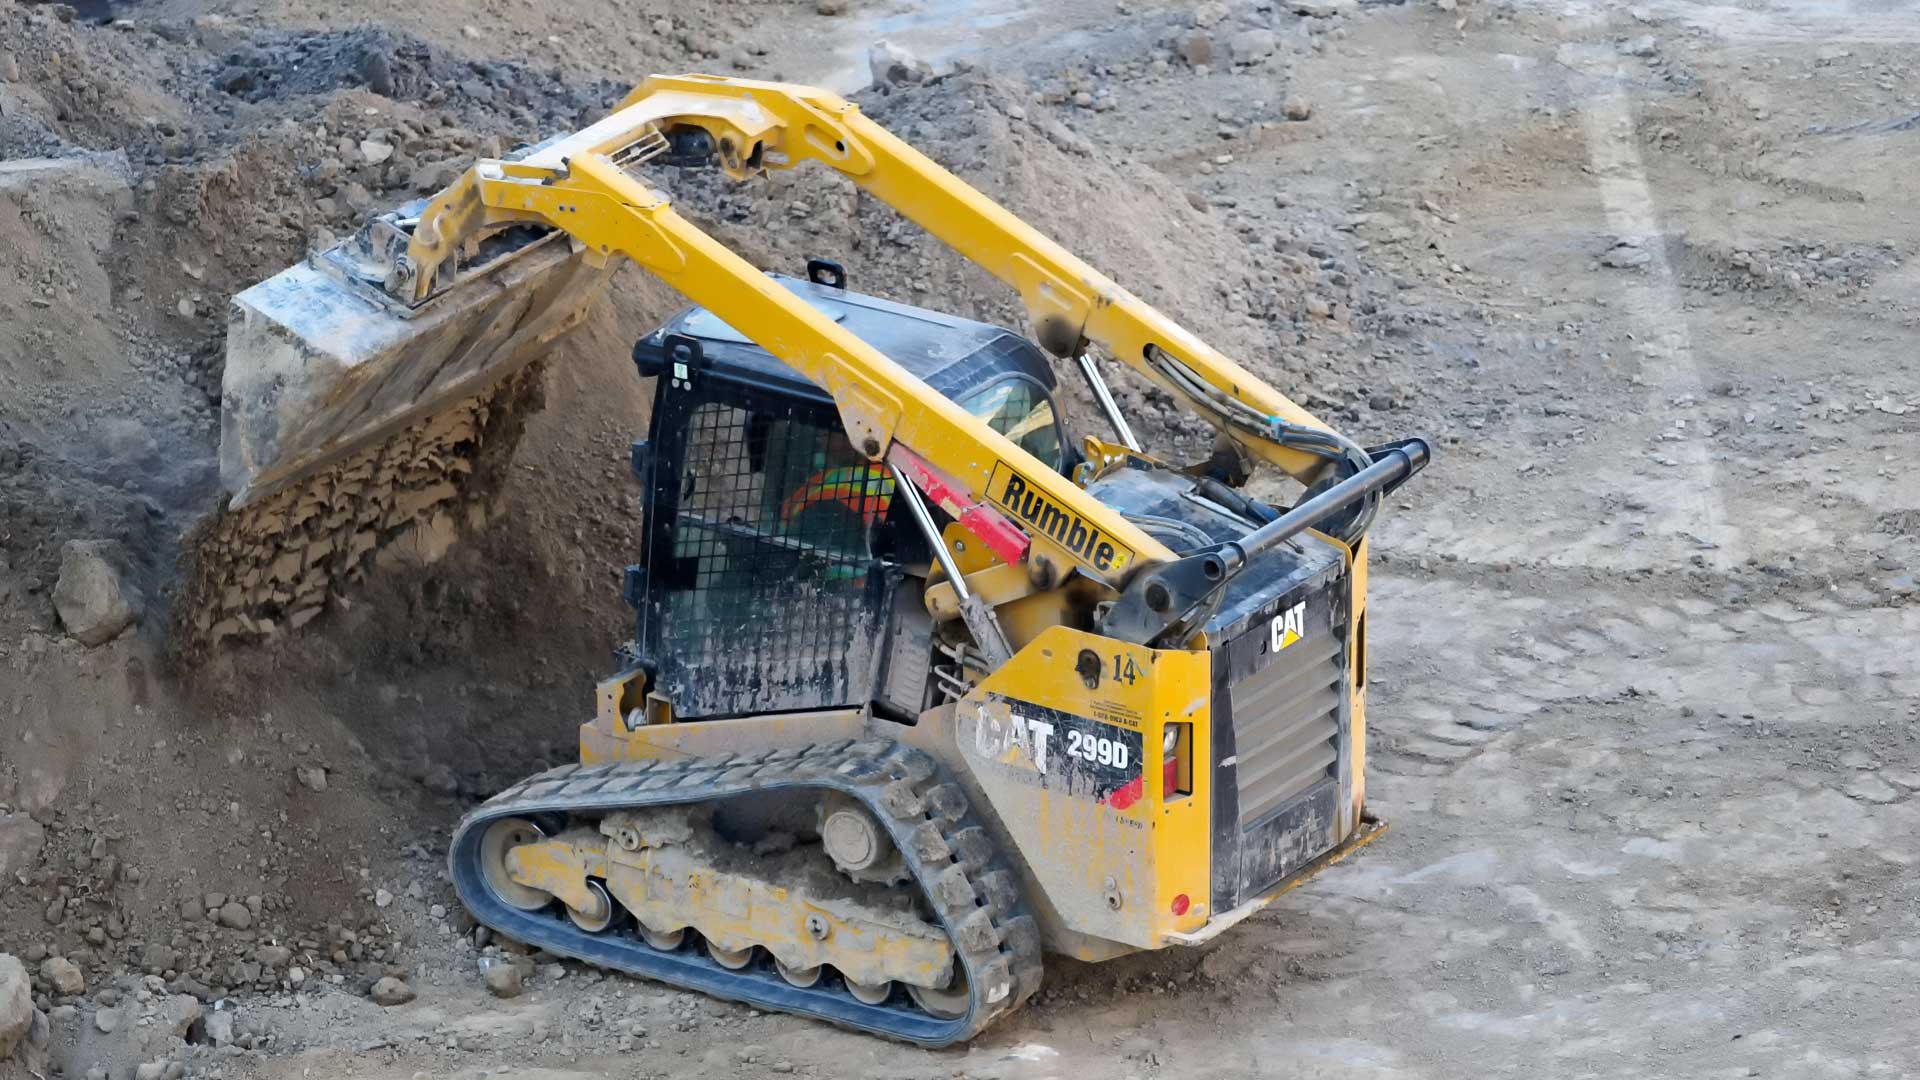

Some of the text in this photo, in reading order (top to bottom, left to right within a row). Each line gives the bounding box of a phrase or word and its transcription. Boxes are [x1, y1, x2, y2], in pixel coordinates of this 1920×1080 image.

[1002, 473, 1115, 571] Rumble
[1271, 600, 1306, 653] CAT
[1113, 654, 1136, 685] 14
[1067, 729, 1129, 769] 299D
